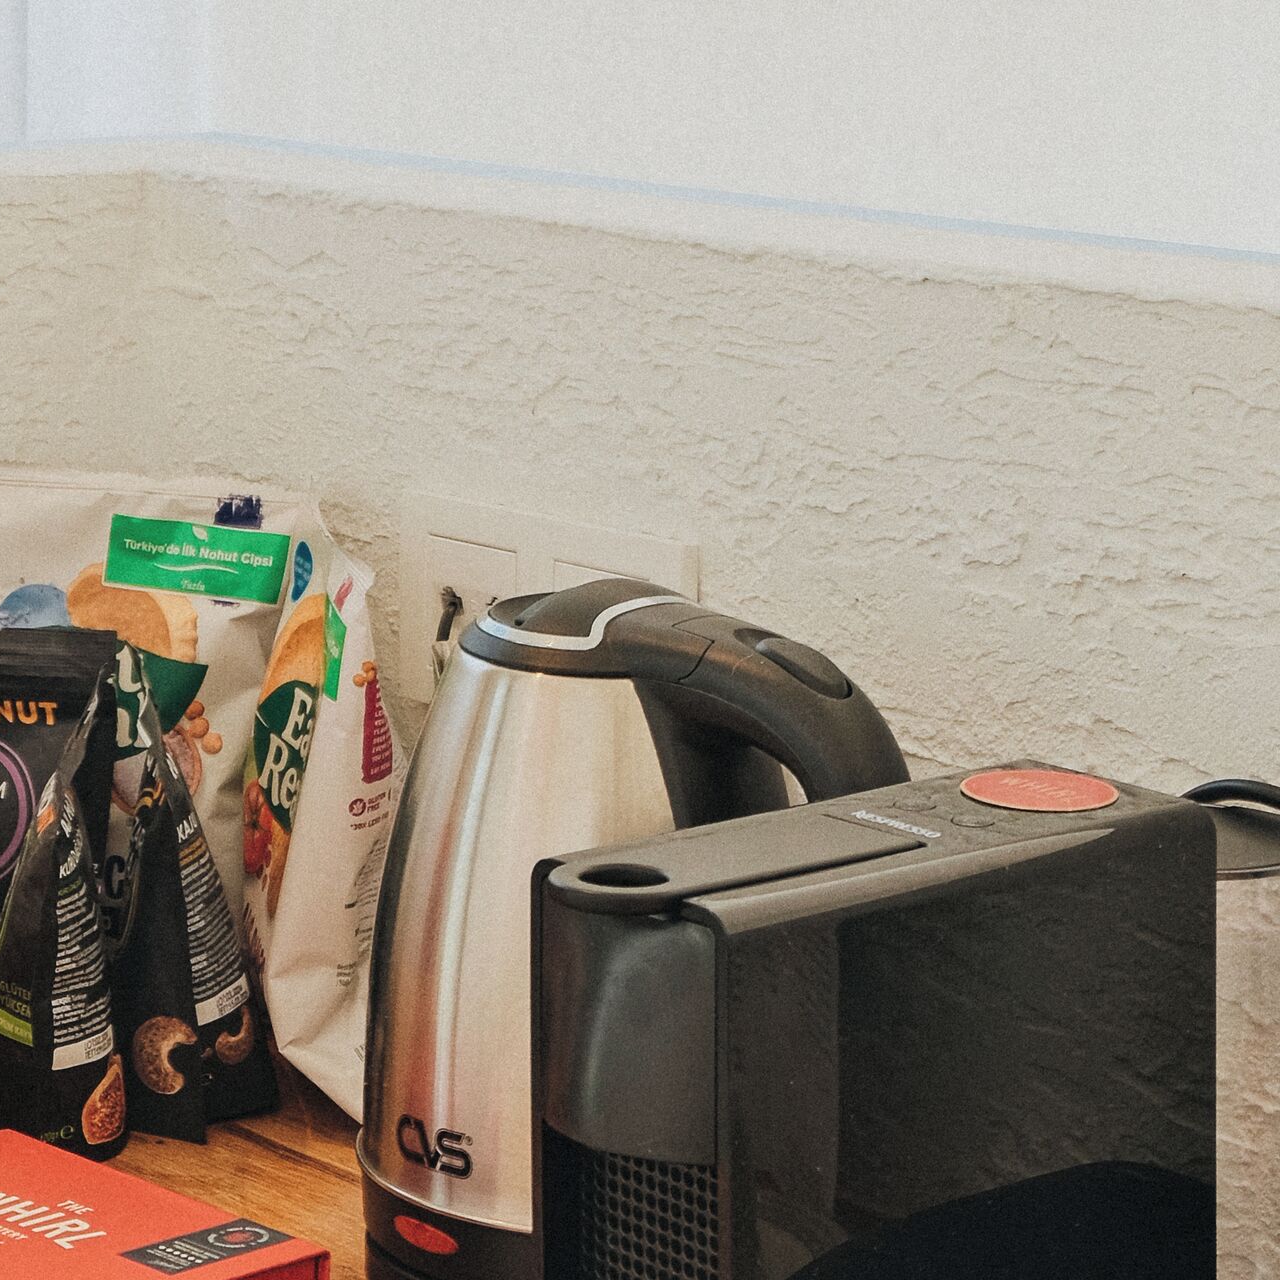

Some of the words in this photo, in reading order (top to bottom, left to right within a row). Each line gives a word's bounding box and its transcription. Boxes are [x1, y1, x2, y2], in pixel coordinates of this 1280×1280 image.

[124, 538, 179, 555] Türkiye'de
[199, 547, 238, 563] Nohut
[241, 552, 274, 567] Cipsi
[57, 1199, 95, 1215] THE
